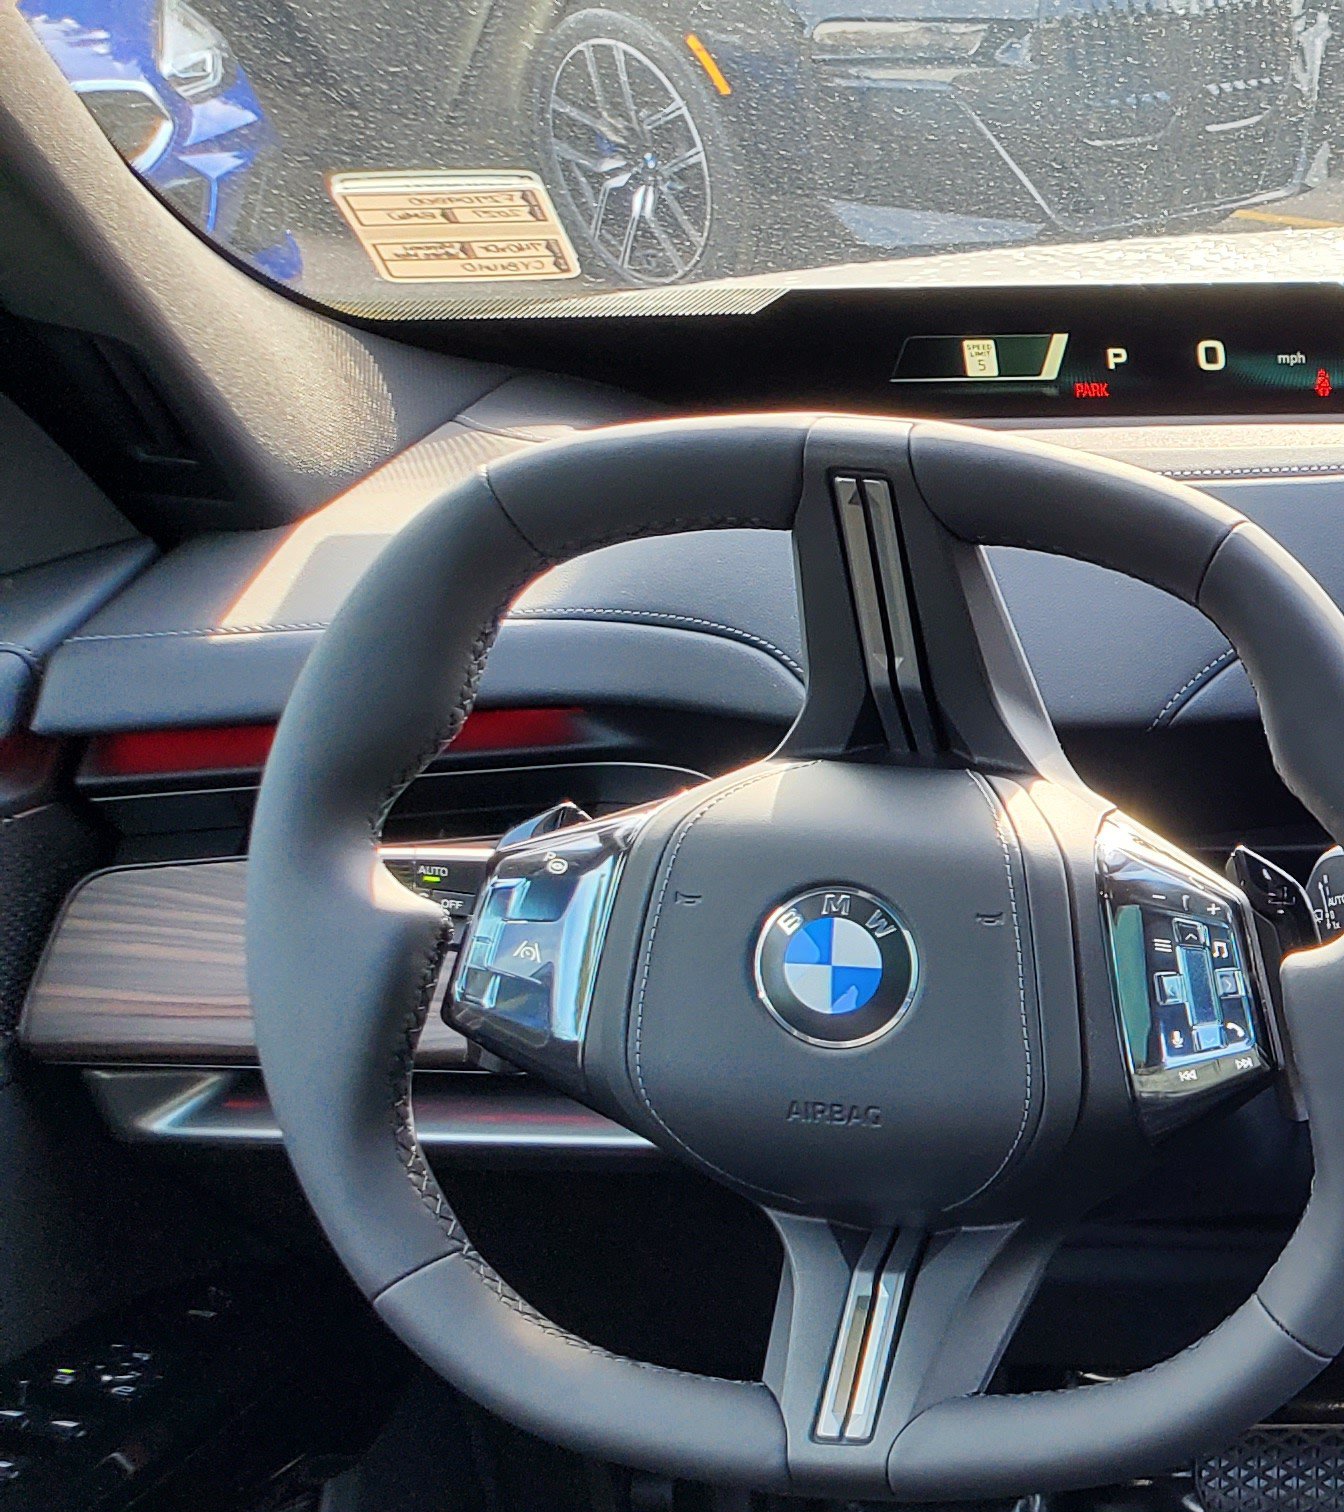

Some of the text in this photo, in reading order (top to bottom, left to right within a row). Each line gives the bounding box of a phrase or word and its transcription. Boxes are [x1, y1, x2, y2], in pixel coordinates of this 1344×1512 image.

[1106, 347, 1128, 370] P
[1197, 339, 1227, 371] 0
[1276, 351, 1306, 366] mph
[978, 359, 986, 372] 5
[1074, 382, 1110, 398] PARK
[418, 865, 449, 877] AUTO
[441, 898, 464, 909] OFF
[776, 893, 897, 938] BMW
[786, 1100, 882, 1127] AIRBAG
